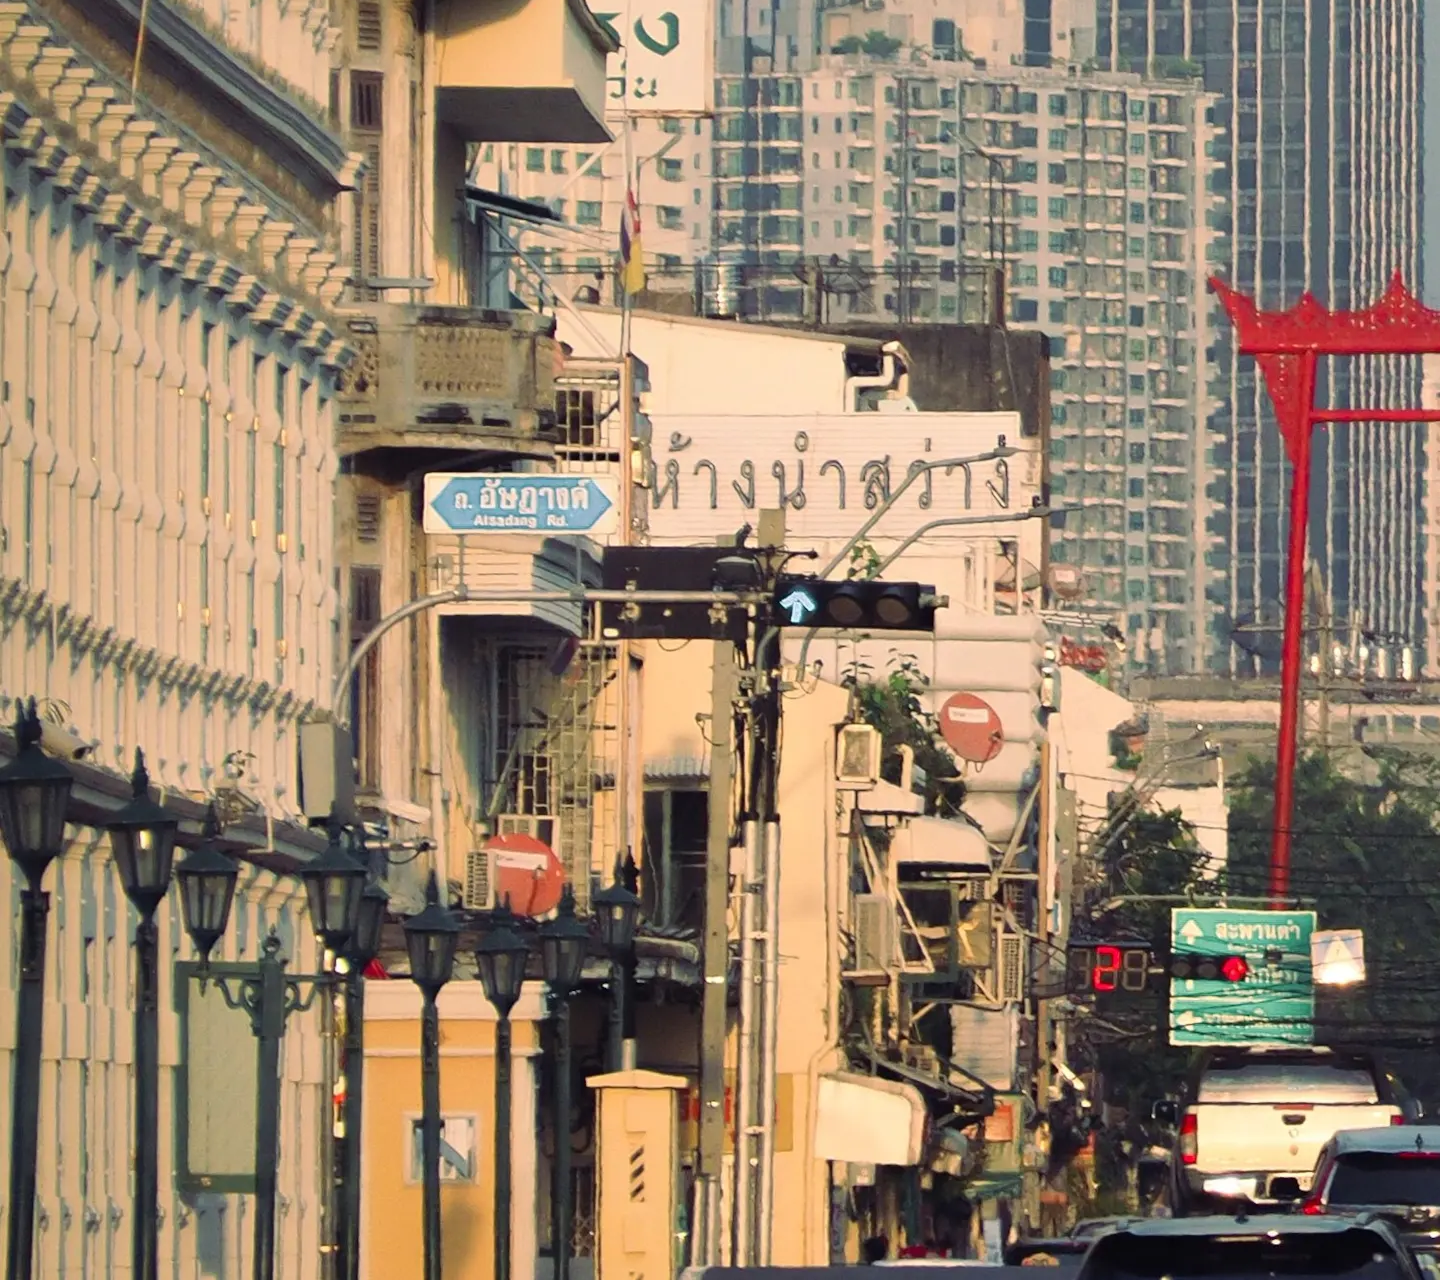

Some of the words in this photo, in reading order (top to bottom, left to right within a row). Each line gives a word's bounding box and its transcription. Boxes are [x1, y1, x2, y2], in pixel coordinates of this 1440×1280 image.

[650, 430, 1009, 510] ห้างนำสว่าง
[454, 491, 473, 510] ถ.
[473, 514, 537, 529] Atsadang
[546, 514, 569, 527] Rd.
